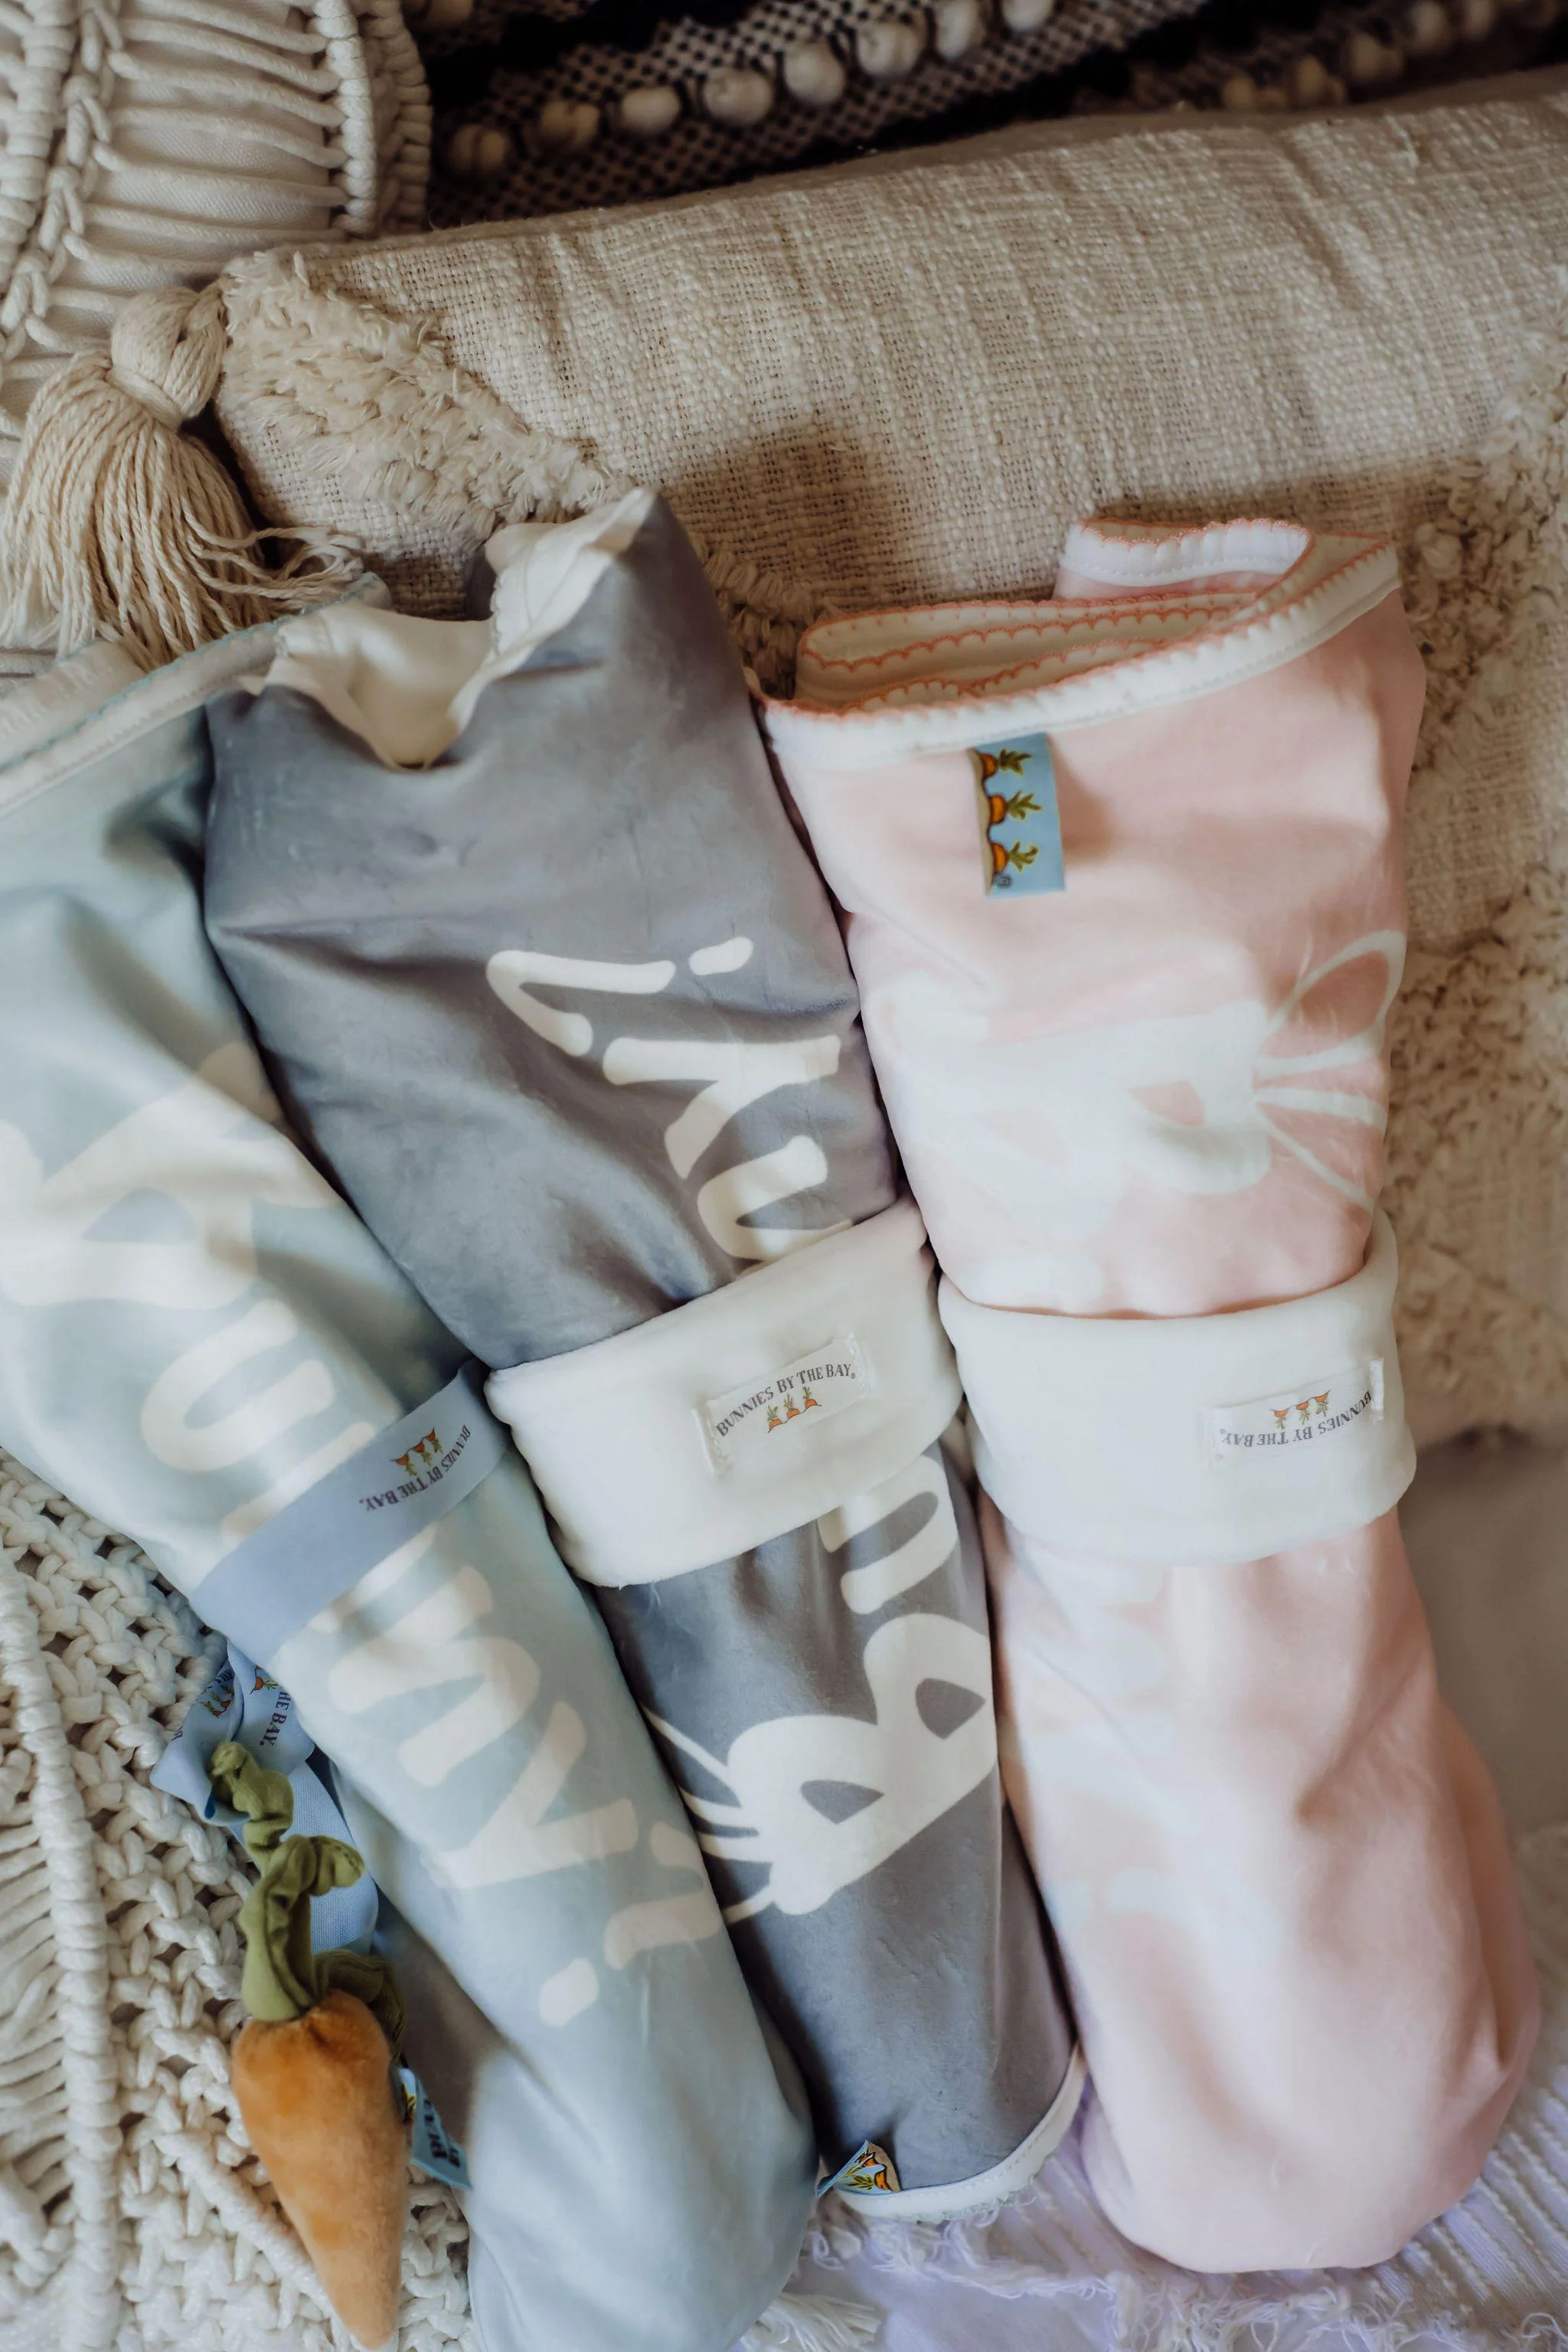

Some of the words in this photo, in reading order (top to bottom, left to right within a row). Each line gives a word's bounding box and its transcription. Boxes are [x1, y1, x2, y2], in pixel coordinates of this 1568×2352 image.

[714, 1386, 774, 1437] BUNNIES
[776, 1374, 797, 1394] BY
[796, 1367, 824, 1385] THE
[1318, 1390, 1373, 1435] BUNNIES
[485, 936, 998, 1916] Buny?
[1292, 1426, 1314, 1442] BY
[440, 1423, 472, 1473] BUNNIES
[1257, 1431, 1289, 1447] THE
[426, 1465, 444, 1485] BY
[397, 1476, 429, 1499] THE
[275, 1690, 292, 1711] HE
